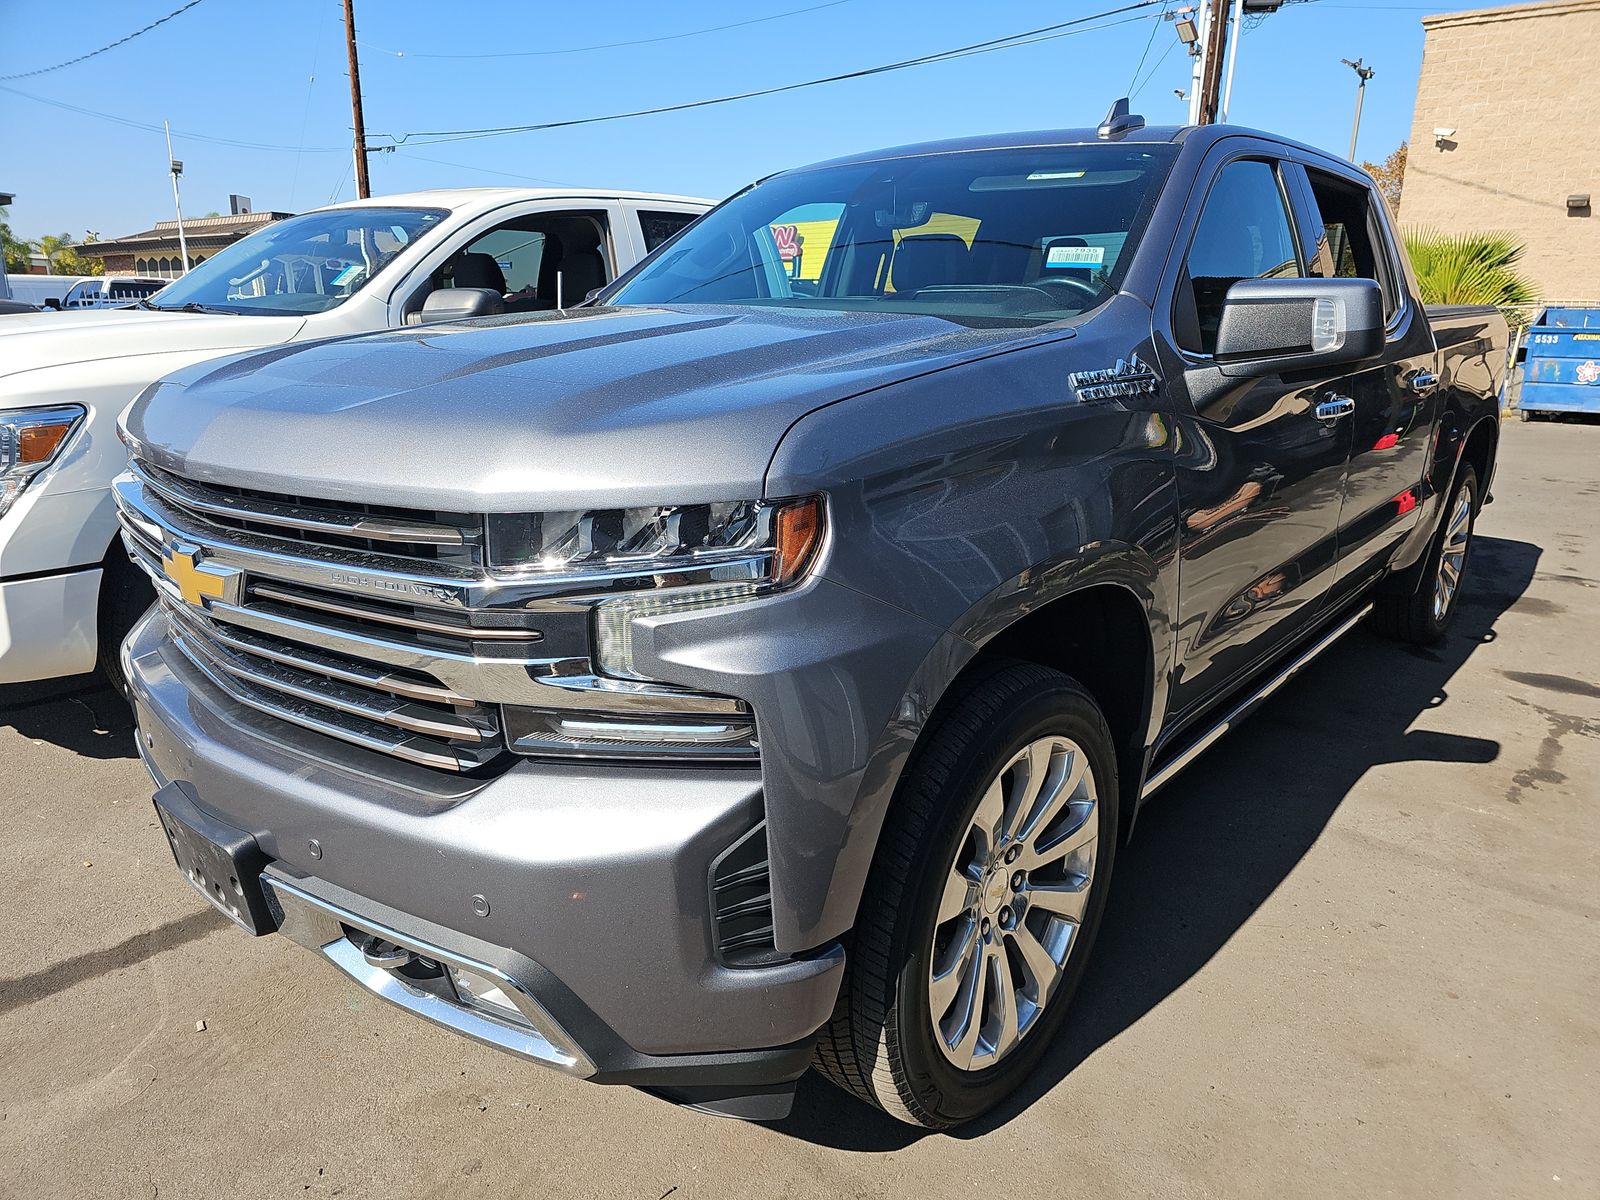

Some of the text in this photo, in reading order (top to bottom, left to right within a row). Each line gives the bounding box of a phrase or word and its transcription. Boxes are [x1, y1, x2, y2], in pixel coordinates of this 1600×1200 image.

[1534, 335, 1559, 344] 5533
[1068, 369, 1117, 387] HIGH
[1076, 379, 1156, 402] COUNTRY
[331, 572, 459, 602] HIGH COUNTRY
